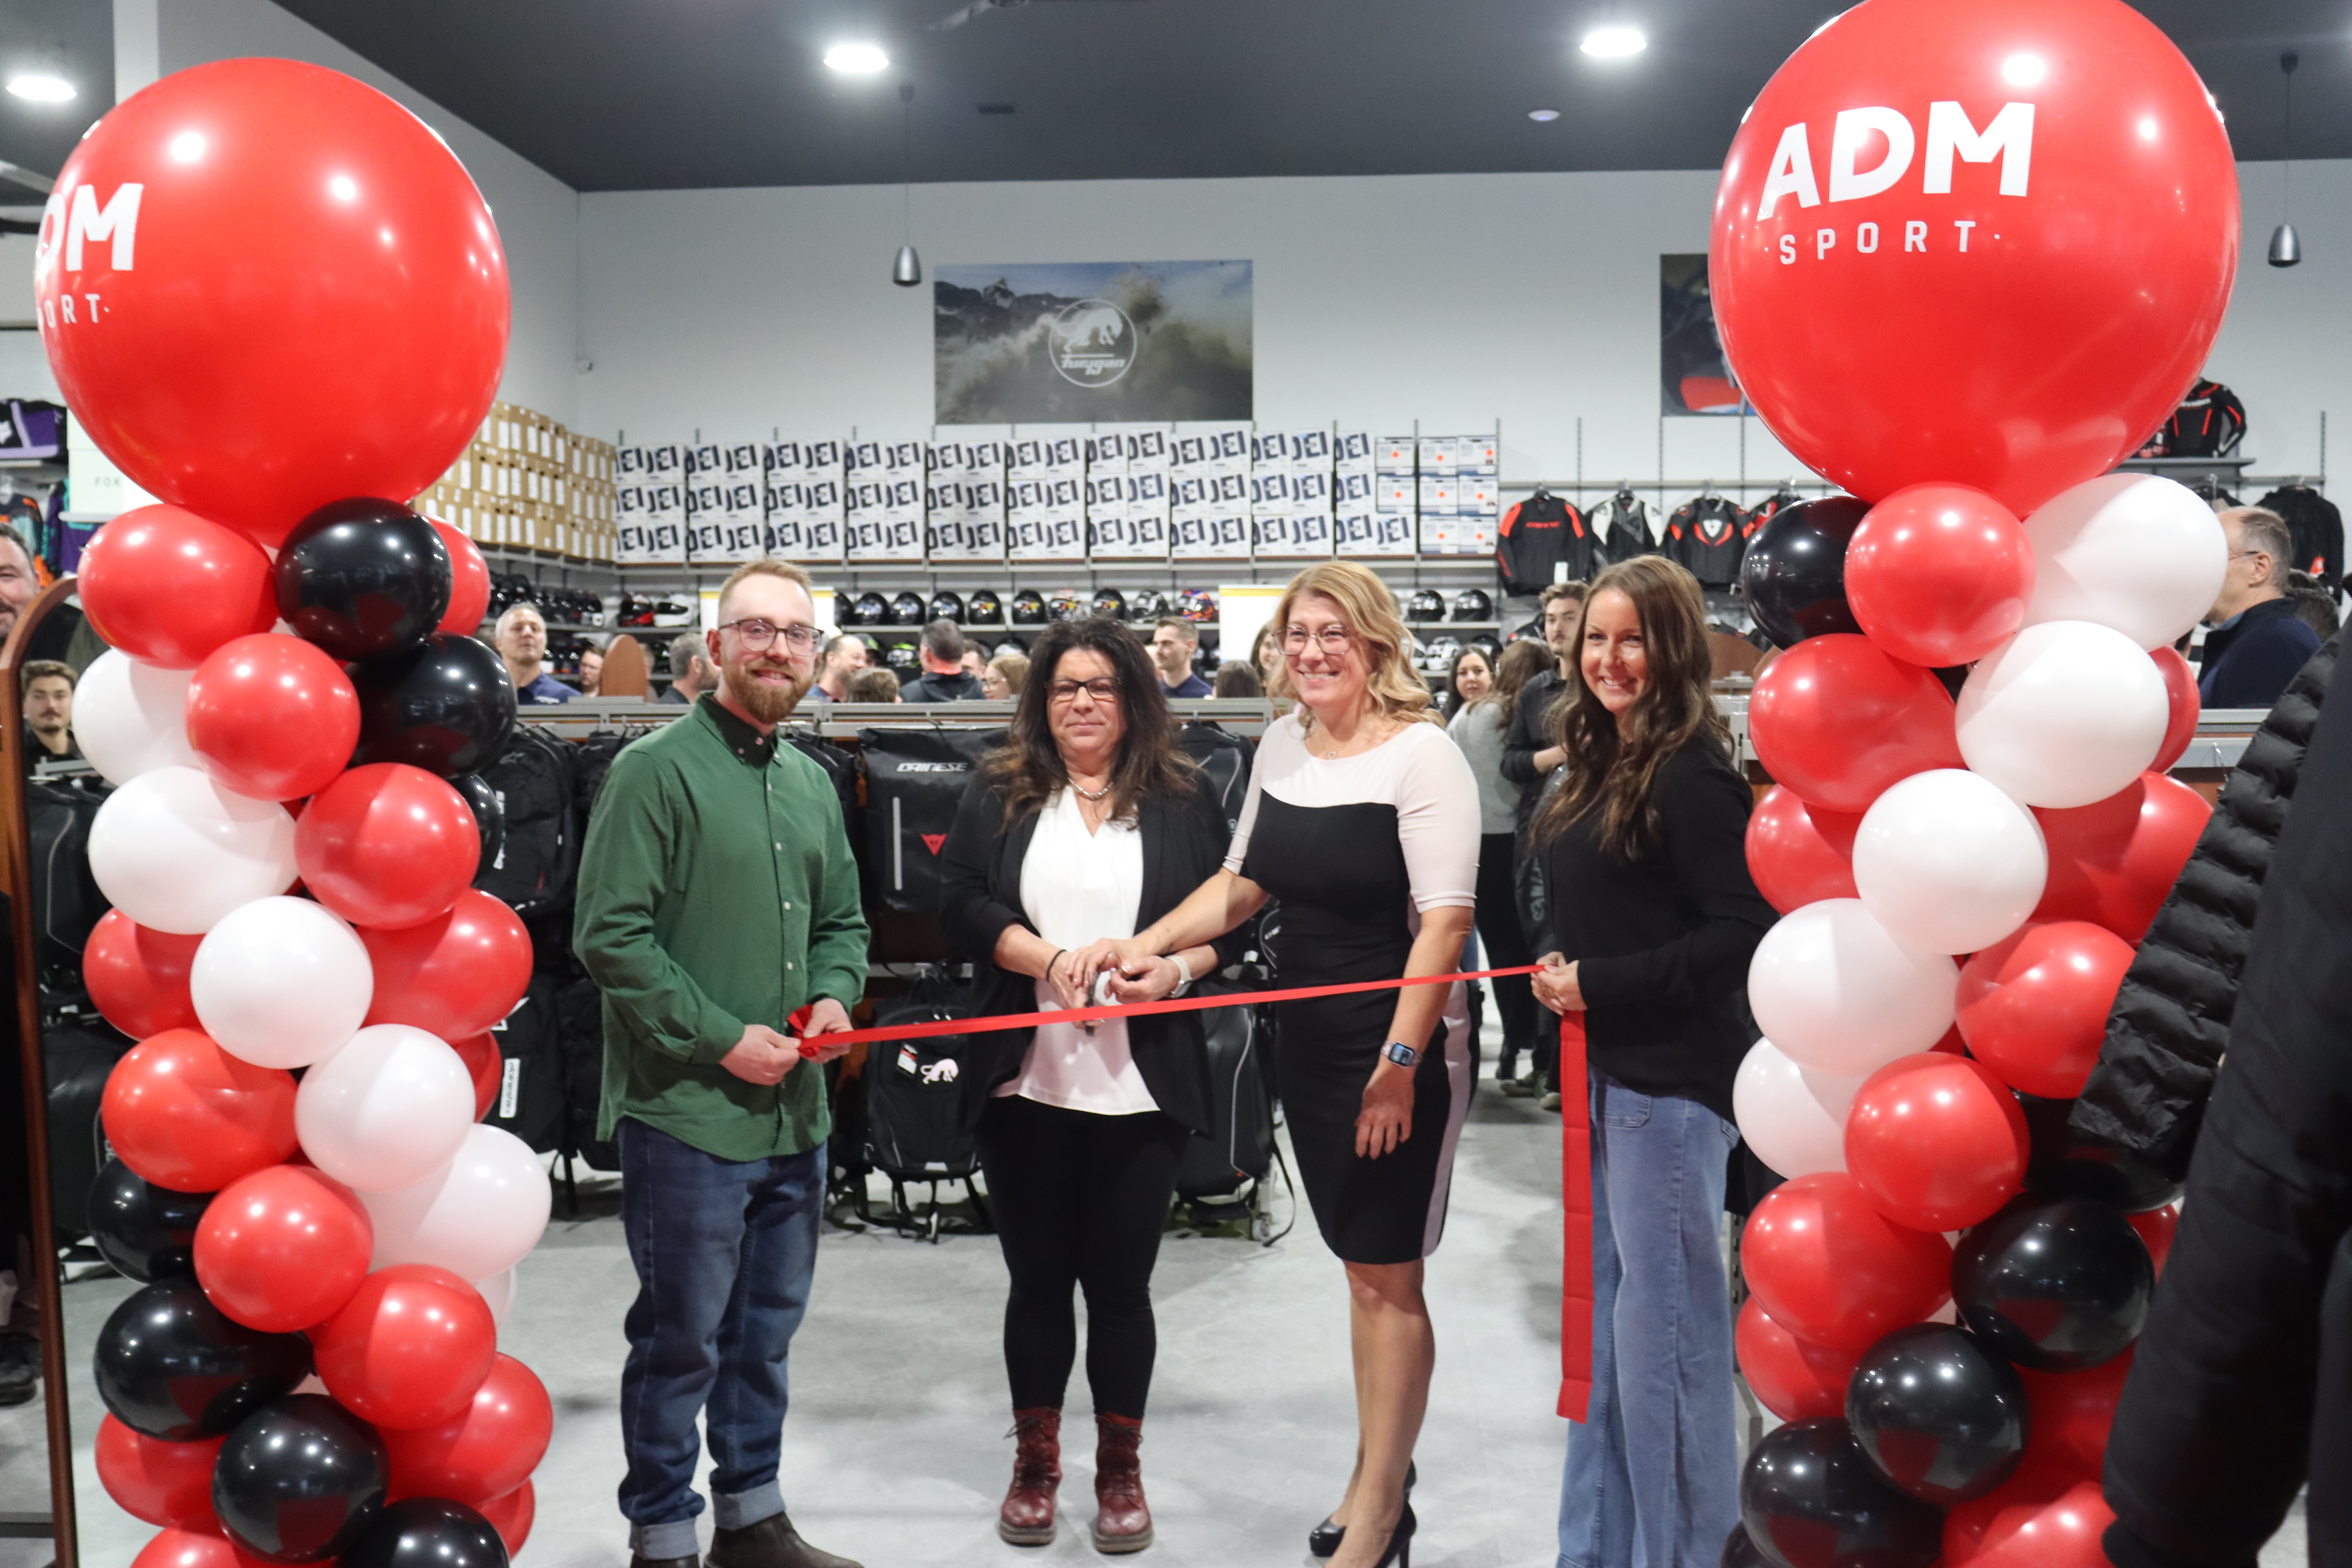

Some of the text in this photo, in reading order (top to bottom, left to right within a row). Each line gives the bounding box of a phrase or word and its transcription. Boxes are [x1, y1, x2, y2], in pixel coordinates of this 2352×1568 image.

[1756, 101, 2035, 222] ADM
[1779, 220, 1976, 265] SPORT
[94, 477, 120, 487] FOX
[896, 762, 968, 772] DAINESE
